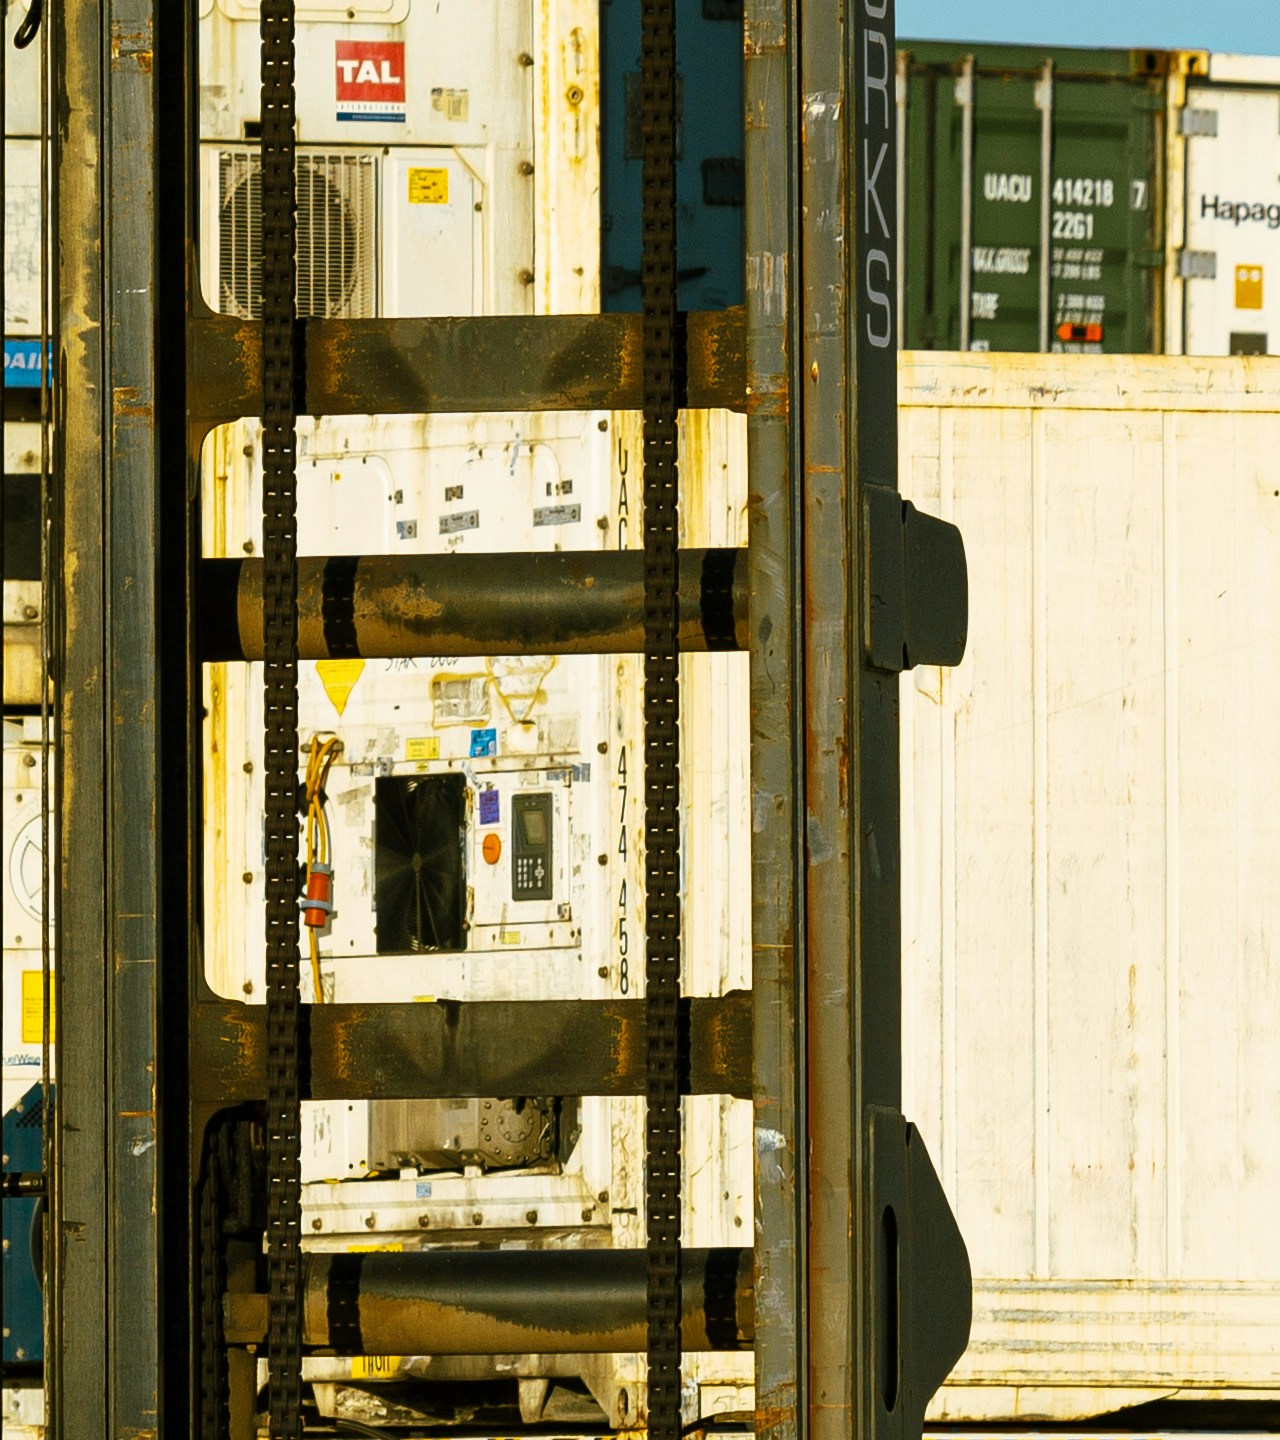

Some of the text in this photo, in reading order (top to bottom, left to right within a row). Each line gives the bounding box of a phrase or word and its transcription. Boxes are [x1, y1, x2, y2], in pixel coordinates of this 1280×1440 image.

[337, 60, 401, 84] TAL
[984, 172, 1033, 203] UACU
[1052, 177, 1114, 207] 414218
[1052, 211, 1095, 241] 22G1
